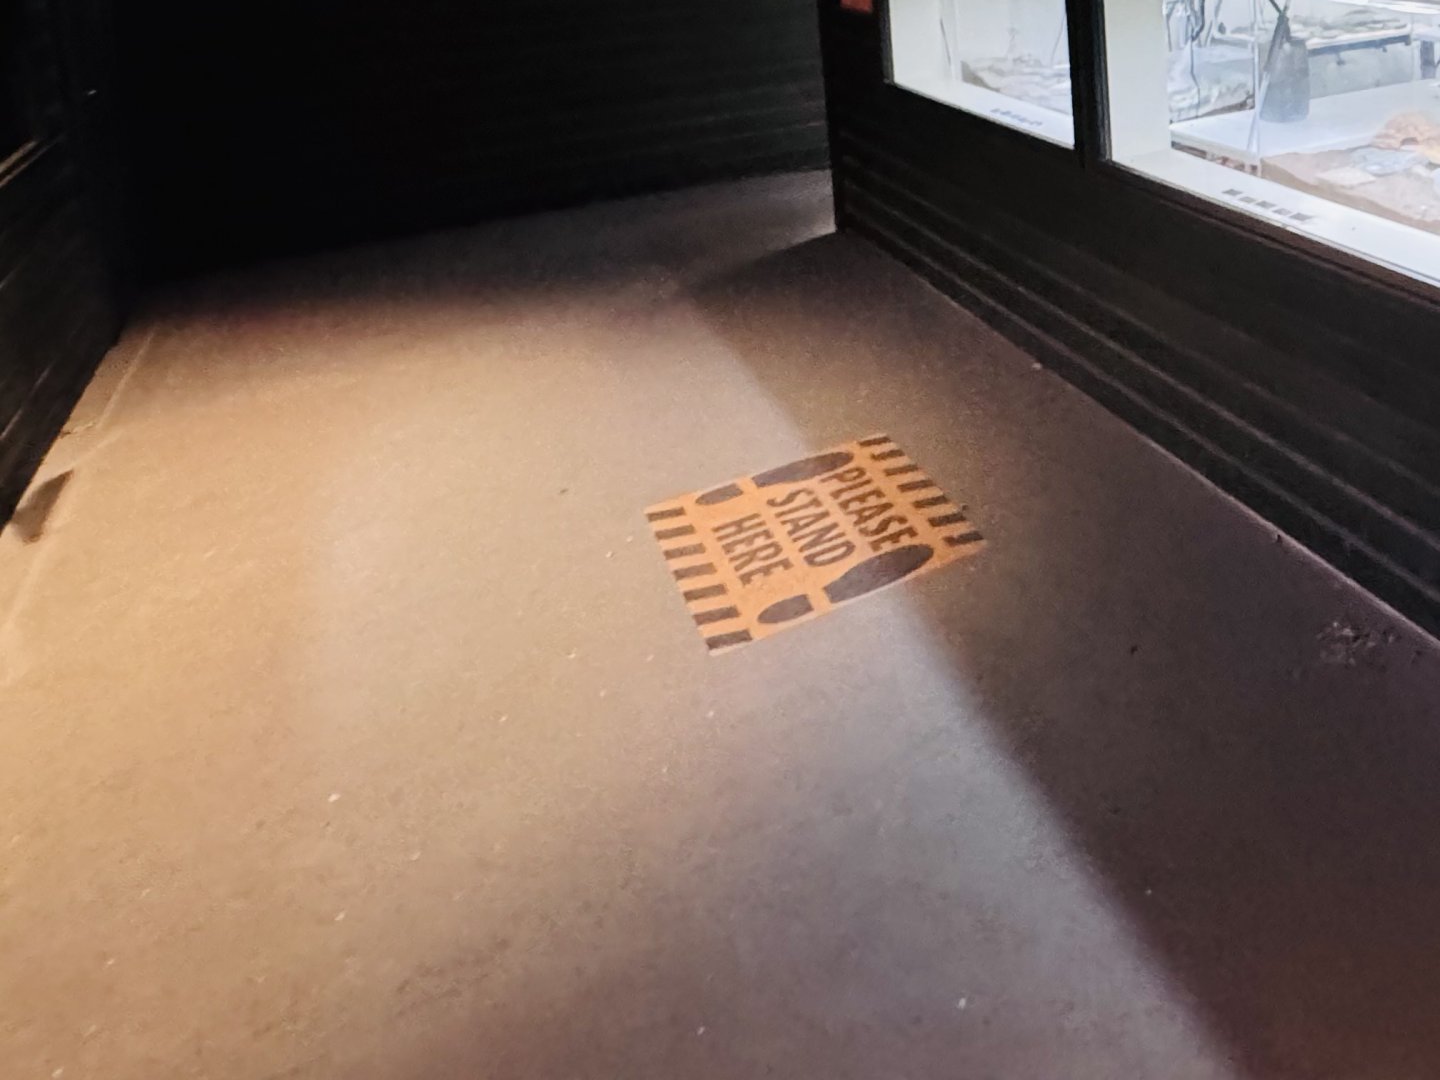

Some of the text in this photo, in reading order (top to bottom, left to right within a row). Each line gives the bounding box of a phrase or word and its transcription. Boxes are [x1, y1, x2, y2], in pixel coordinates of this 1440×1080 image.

[767, 488, 857, 568] STAND
[821, 466, 919, 552] PLEASE
[712, 513, 794, 587] HERE
